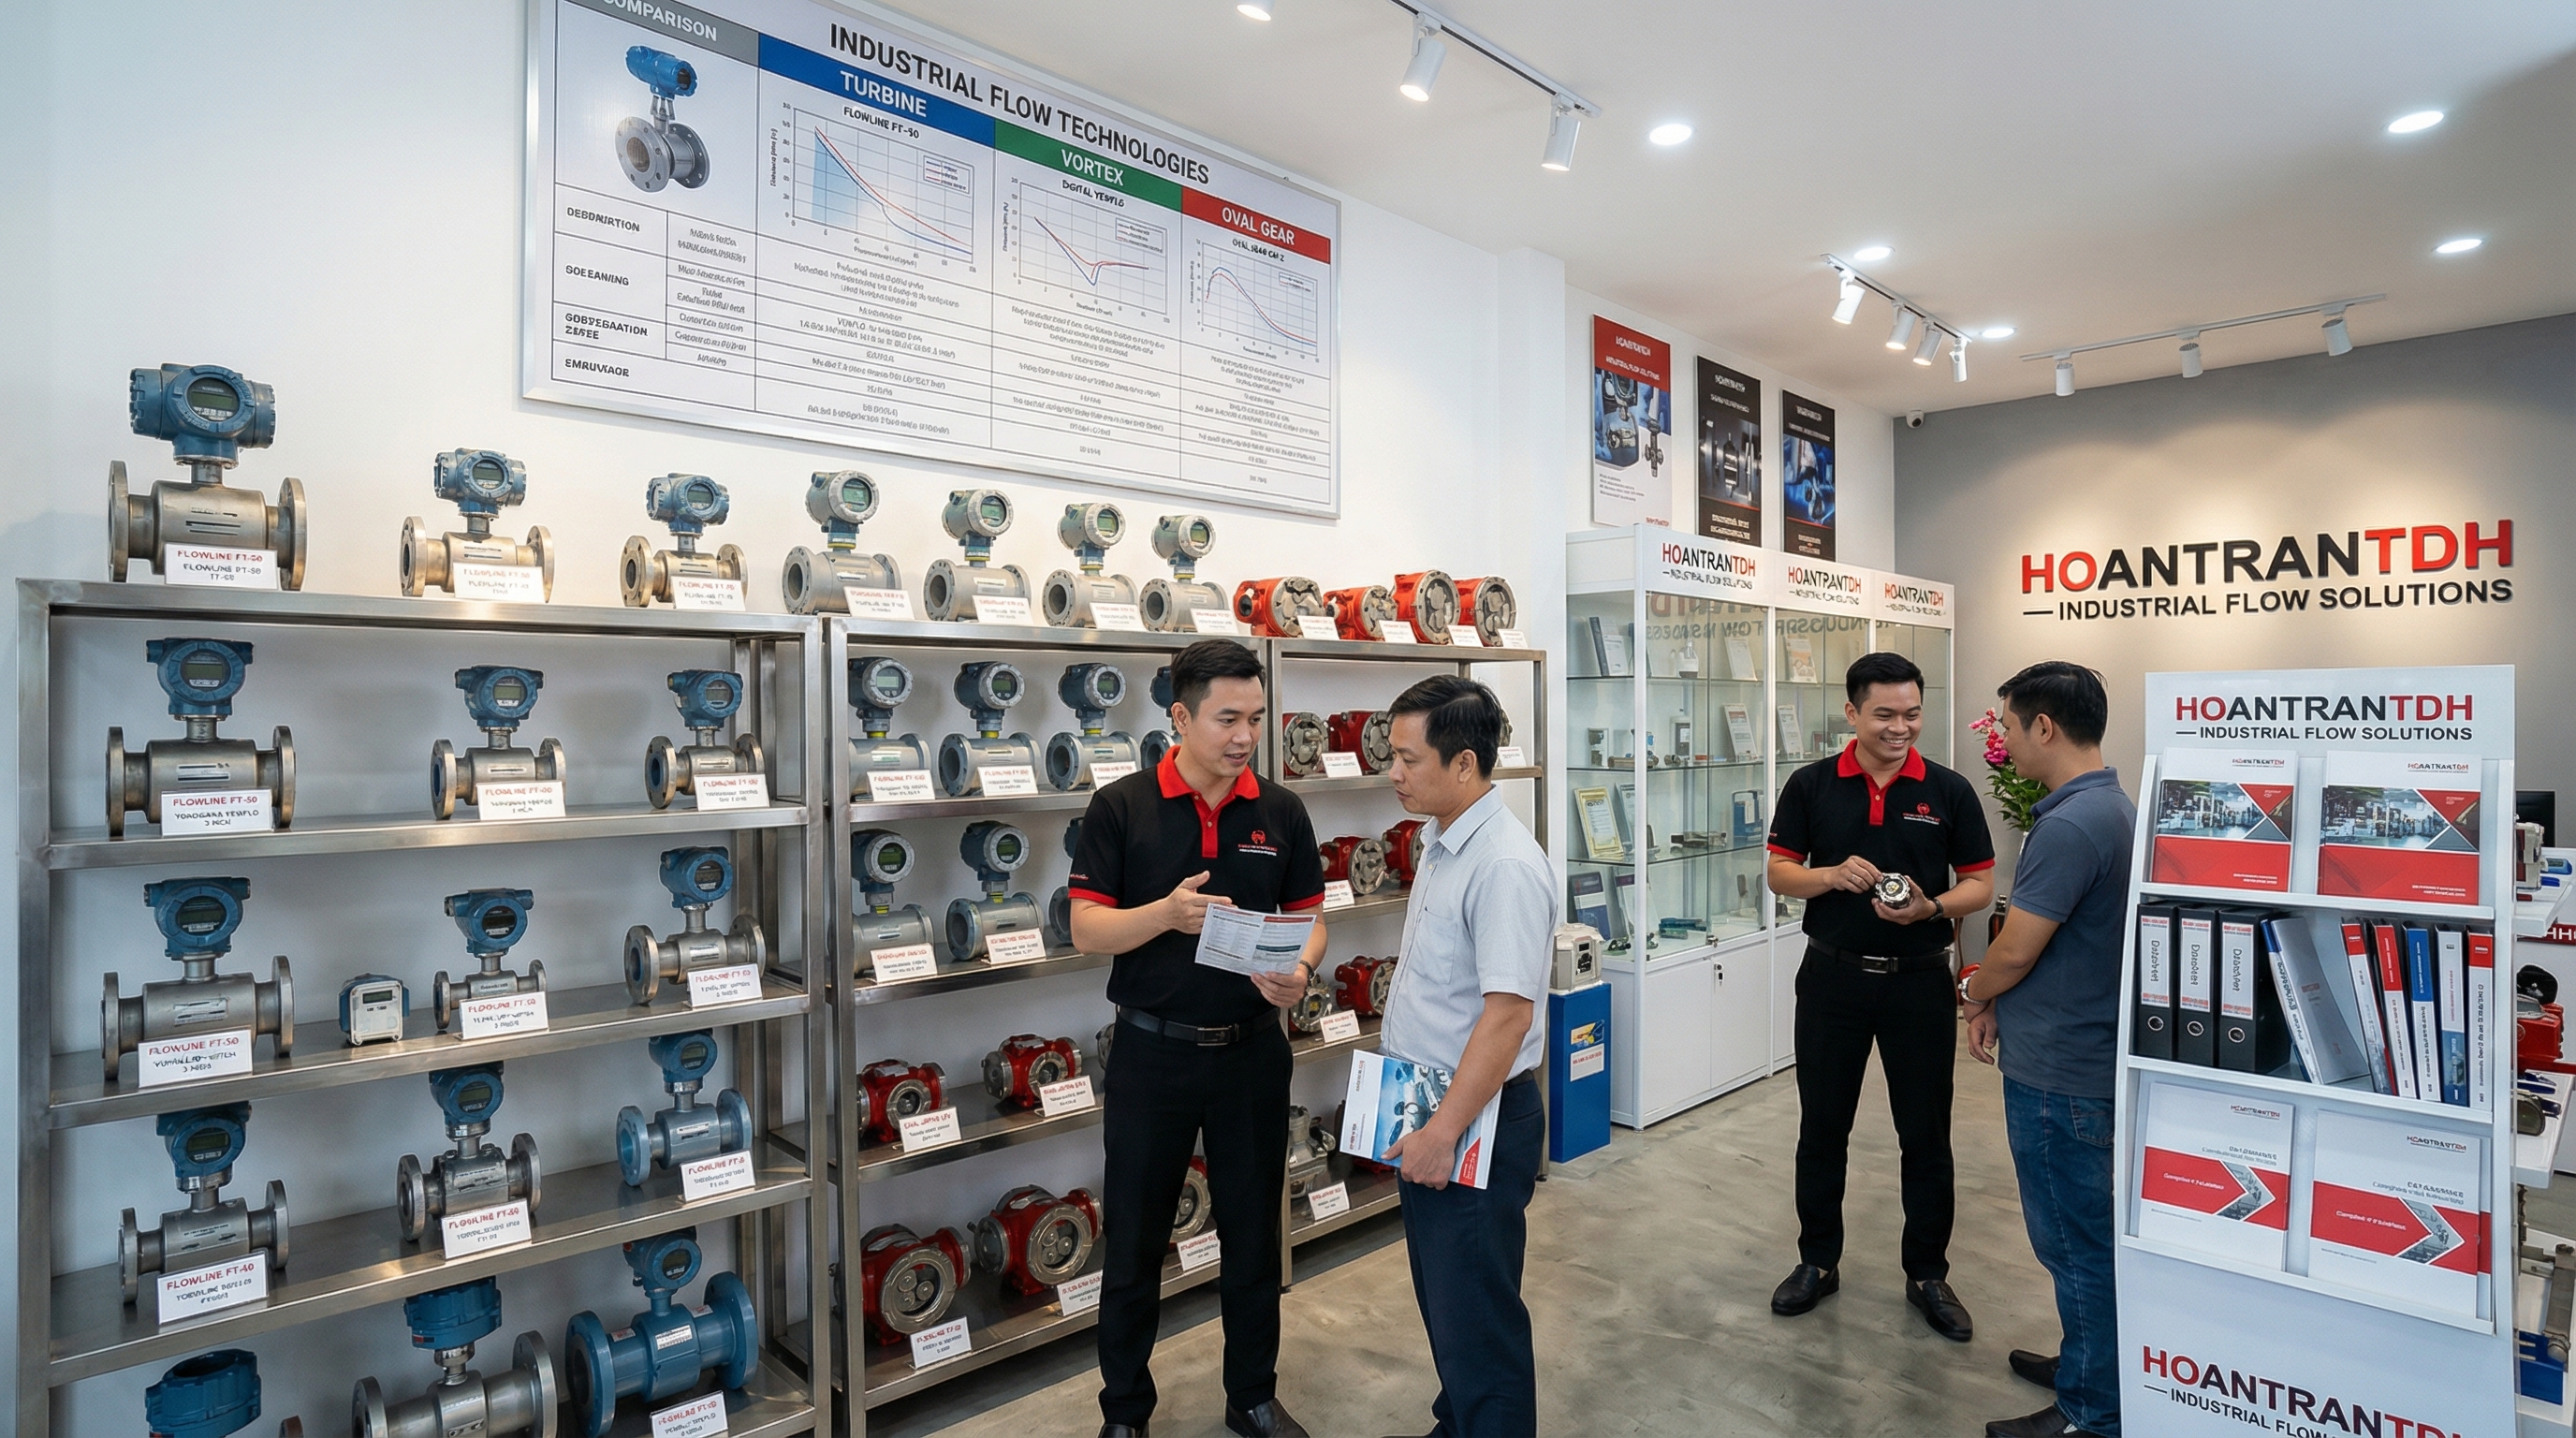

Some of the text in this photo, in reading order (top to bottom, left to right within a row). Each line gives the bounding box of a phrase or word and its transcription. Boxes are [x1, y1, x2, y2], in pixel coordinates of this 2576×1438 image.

[604, 0, 718, 41] OMPARISON
[830, 22, 1210, 185] INDUSTRIAL FLOW TECHNOLOGIES
[840, 69, 928, 118] TURBINE
[1061, 148, 1123, 187] VORTEX
[1221, 206, 1295, 246] OVAL GEAR
[1661, 542, 1756, 578] HOANTRANTDH
[2021, 519, 2513, 594] HOANTRANTDH
[2058, 579, 2513, 622] INDUSTRIAL FLOW SOLUTIONS
[2175, 694, 2474, 722] HOANTRANTDH
[2200, 726, 2474, 741] INDUSTRIAL FLOW SOLUTIONS
[172, 796, 258, 807] FLOWLINE FT-50
[166, 1269, 224, 1291] FLOWLINE
[2171, 1388, 2271, 1430] INDUSTRIAL
